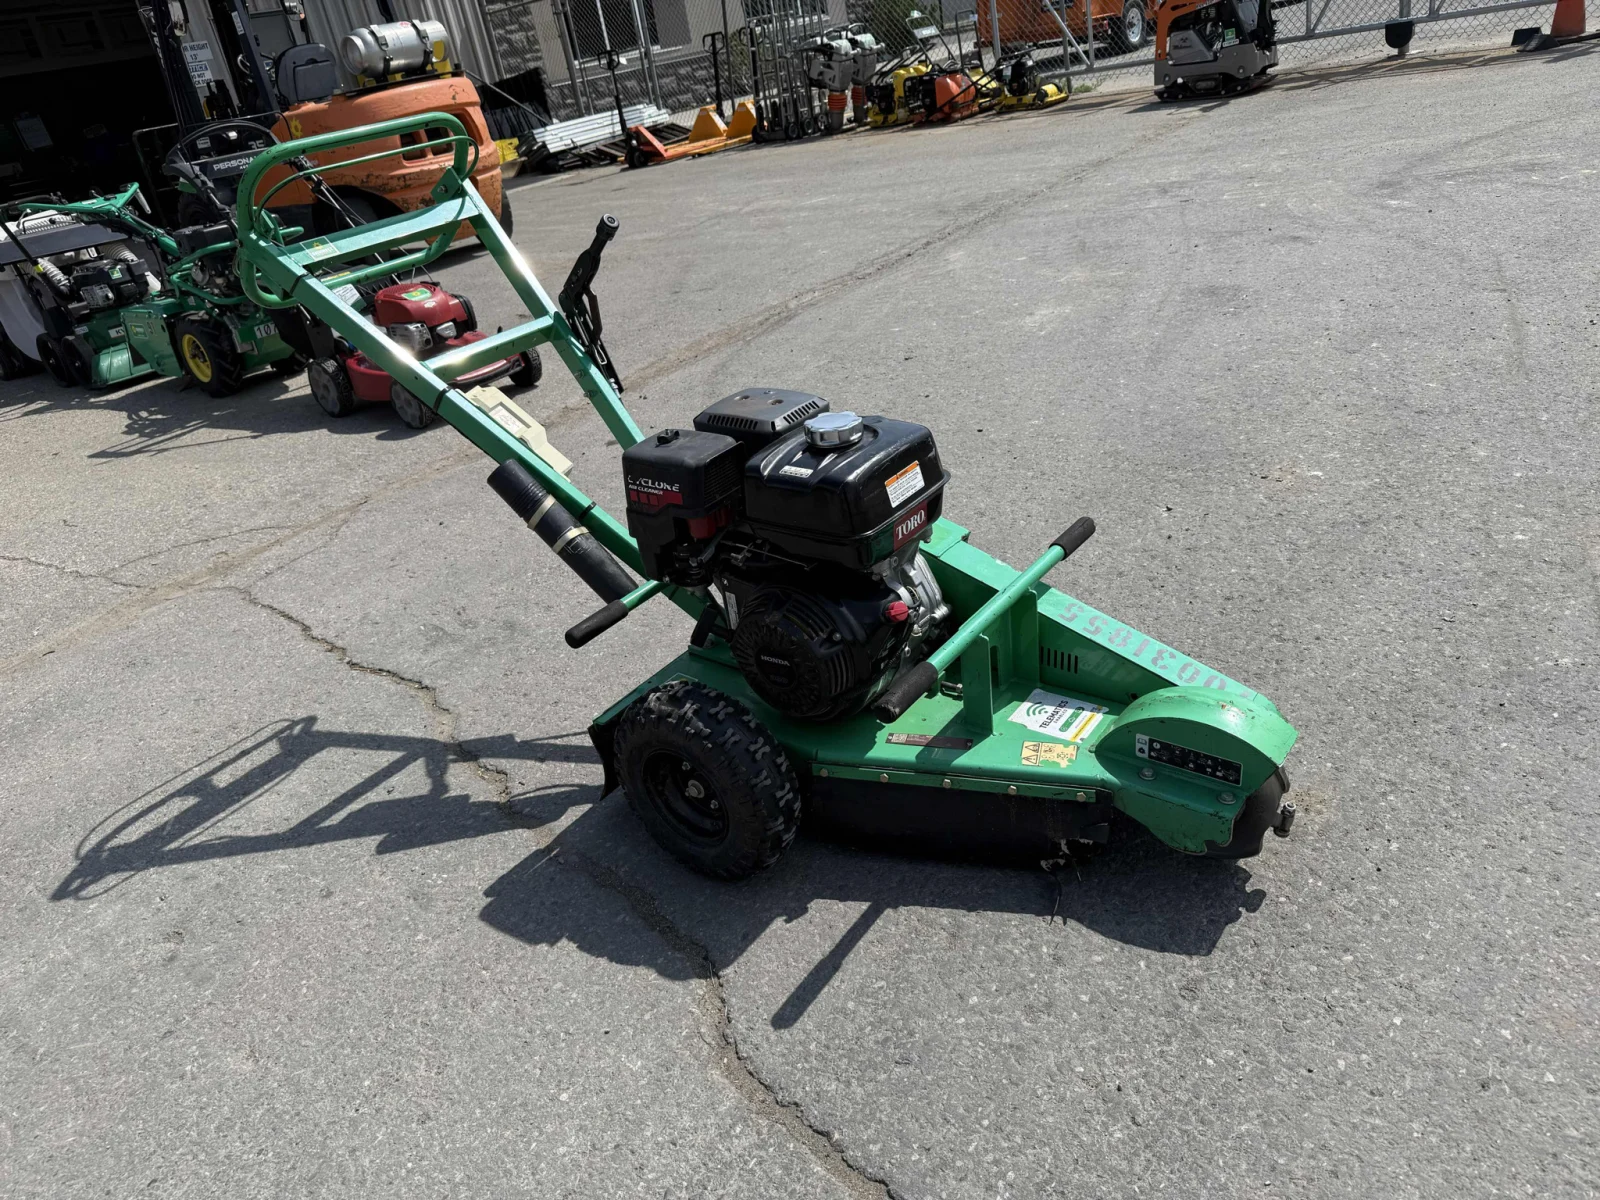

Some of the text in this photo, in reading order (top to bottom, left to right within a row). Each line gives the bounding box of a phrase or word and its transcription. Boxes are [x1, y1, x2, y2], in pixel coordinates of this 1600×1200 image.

[189, 43, 208, 51] HEIGHT
[213, 155, 258, 170] PERSONA
[638, 486, 664, 495] CLEANER
[896, 508, 927, 538] TORO
[760, 654, 791, 667] HONDA
[1038, 699, 1070, 729] TELEMATICS
